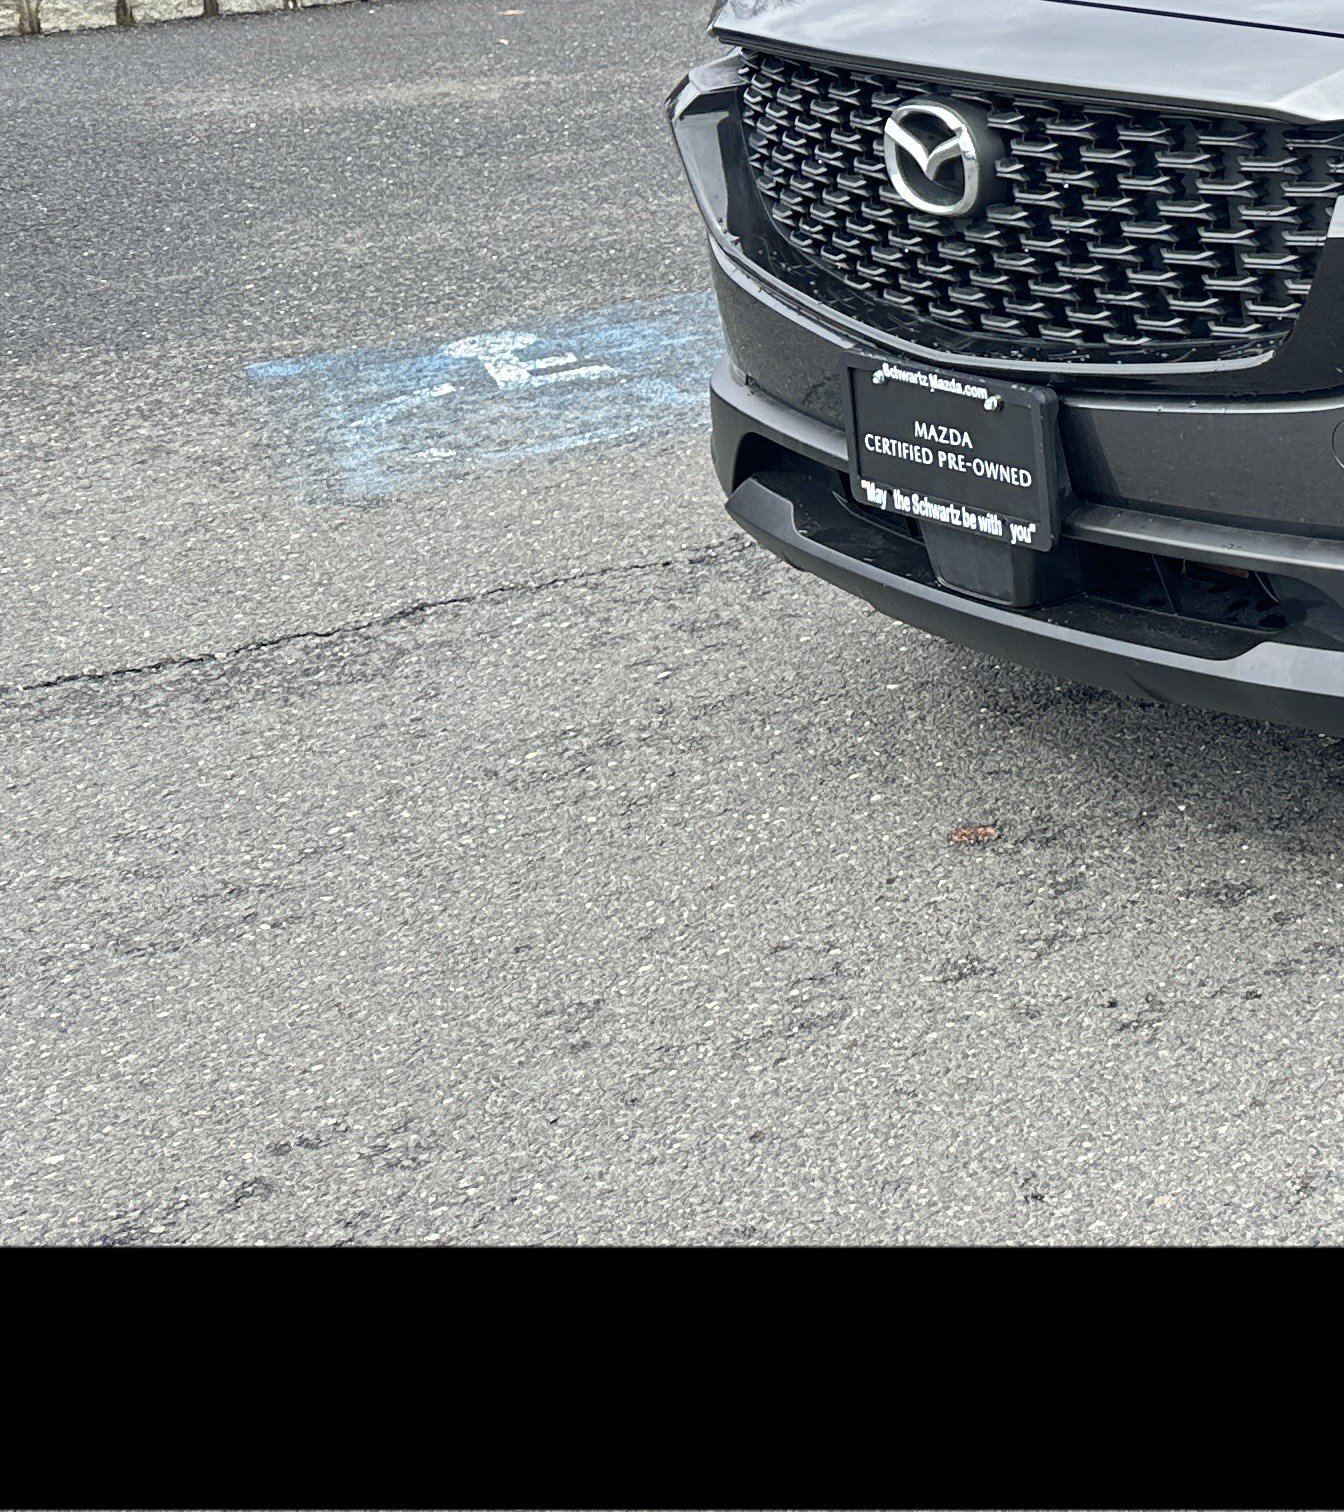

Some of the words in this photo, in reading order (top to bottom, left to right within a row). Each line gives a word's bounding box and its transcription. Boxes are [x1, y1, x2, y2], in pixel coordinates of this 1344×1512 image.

[864, 433, 933, 465] CERTIFIED
[937, 450, 1032, 488] PRE-OWNED
[914, 420, 973, 449] MAZDA
[893, 489, 911, 512] the
[911, 493, 962, 526] Schwartz
[962, 506, 977, 530] be
[977, 512, 1003, 537] with
[1009, 522, 1036, 545] you"
